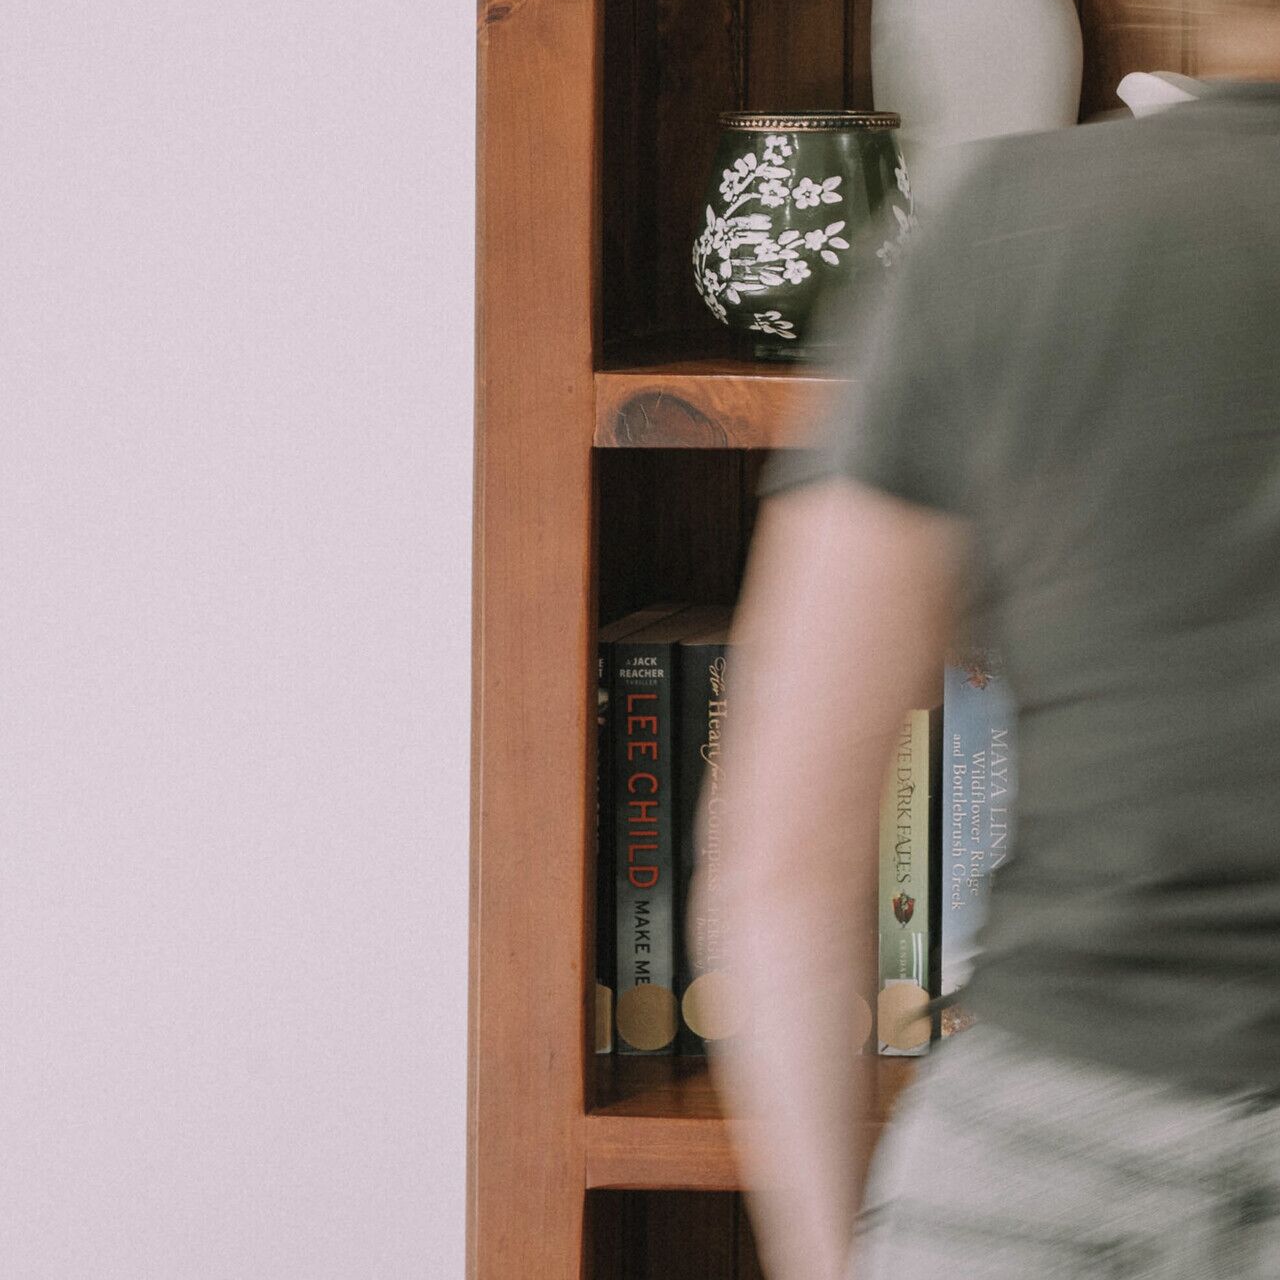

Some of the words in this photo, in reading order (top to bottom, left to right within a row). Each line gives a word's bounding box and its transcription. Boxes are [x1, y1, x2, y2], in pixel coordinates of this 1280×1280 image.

[619, 669, 665, 678] REACHER
[632, 657, 657, 666] JACK
[627, 693, 658, 761] LEE
[952, 734, 965, 757] and
[990, 728, 1009, 799] MAYA
[896, 768, 916, 819] DARK
[952, 764, 968, 857] Bottlebrush
[970, 750, 986, 844] Wildflower
[627, 772, 660, 888] CHILD
[951, 864, 967, 910] Creek
[966, 850, 985, 897] Ridge
[634, 900, 651, 954] MAKE
[634, 960, 651, 986] ME
